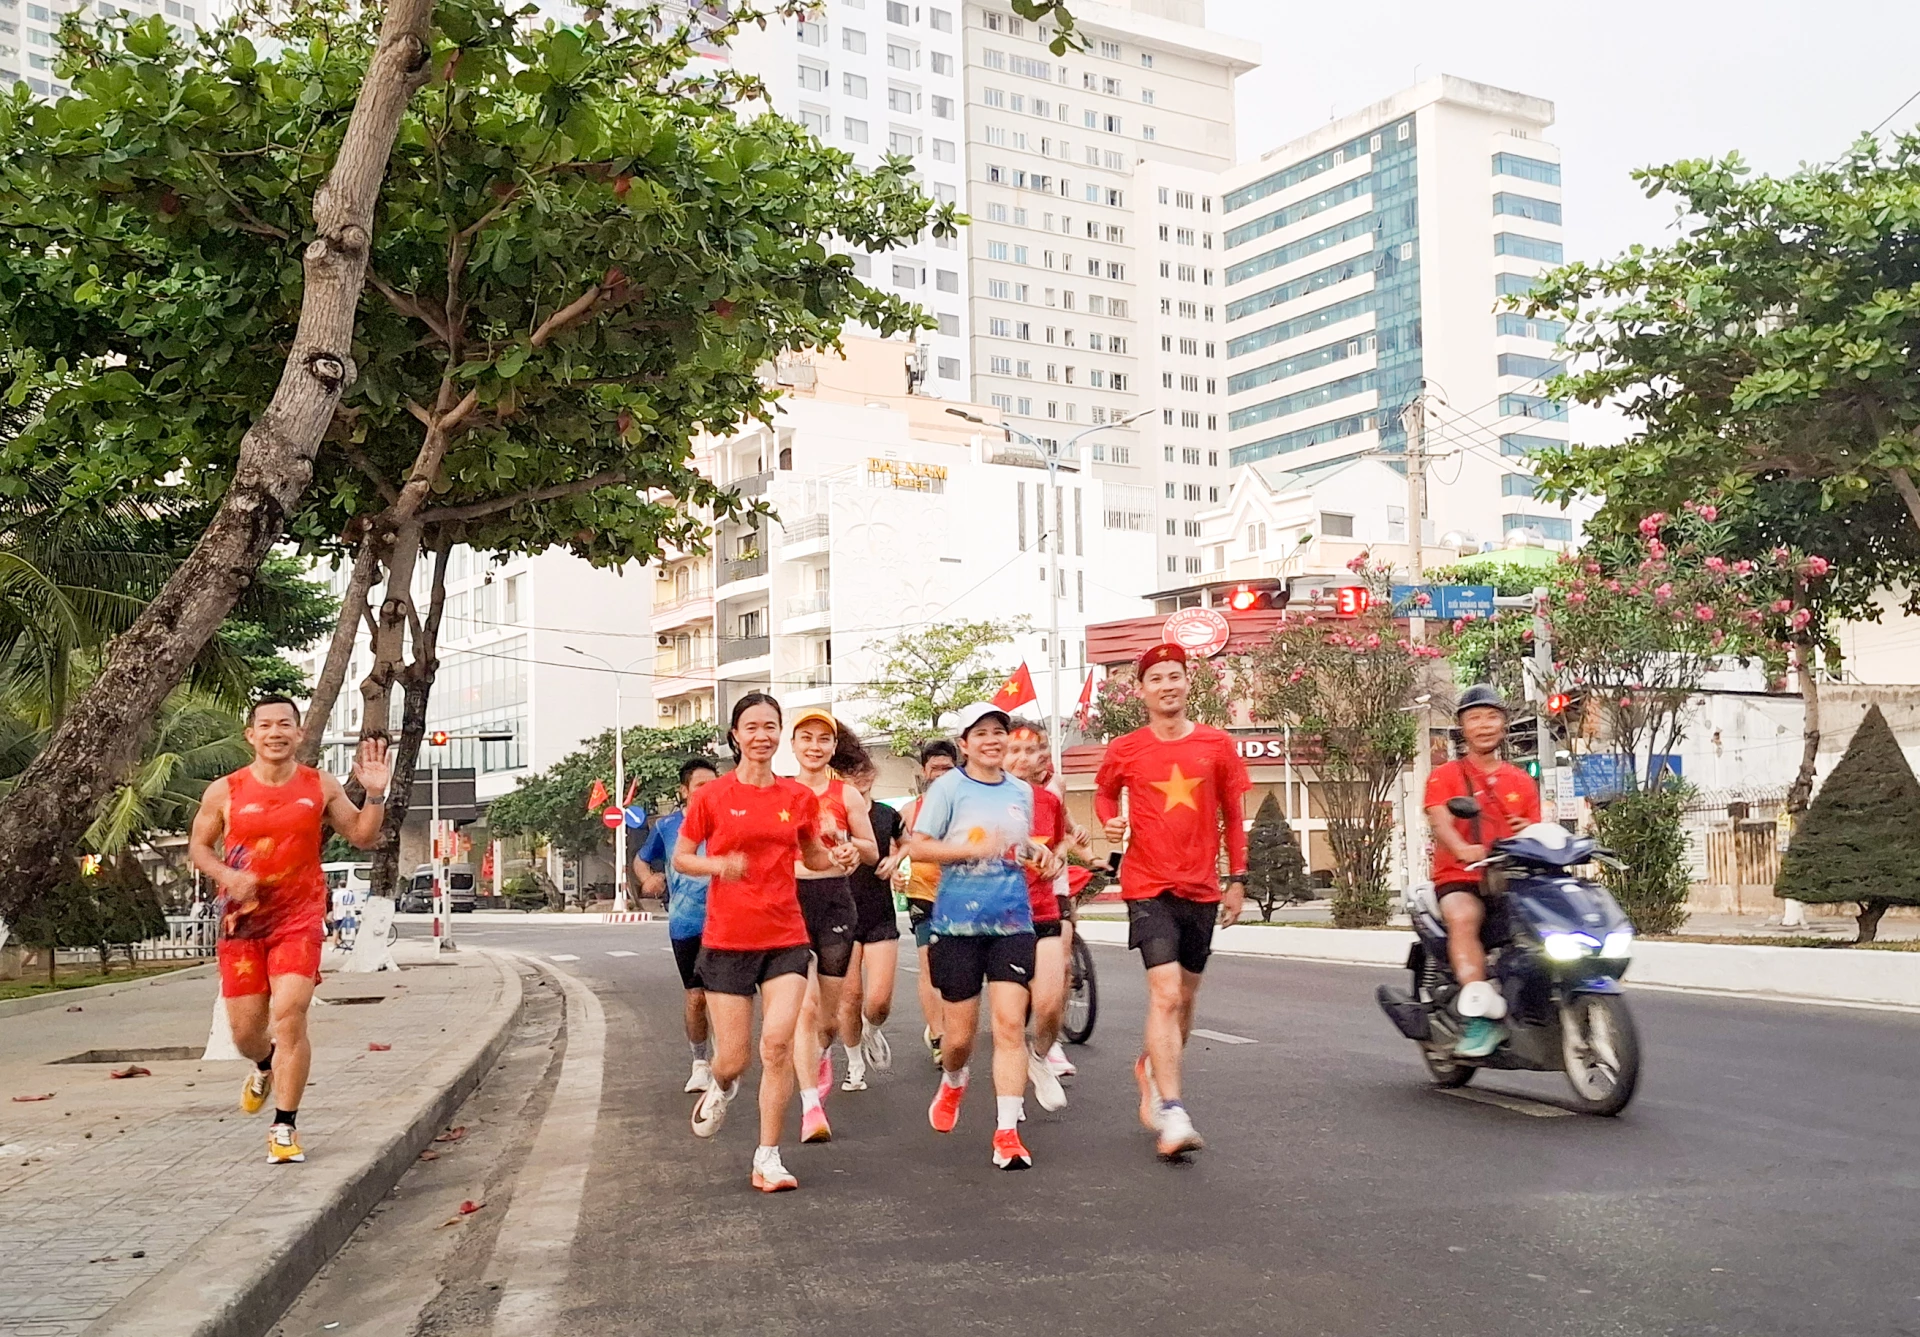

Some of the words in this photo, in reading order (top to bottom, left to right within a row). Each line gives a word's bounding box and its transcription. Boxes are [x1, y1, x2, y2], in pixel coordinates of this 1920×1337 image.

[906, 462, 947, 480] NAM
[892, 478, 927, 488] HOTEL
[1166, 610, 1226, 632] HIGHLANDS
